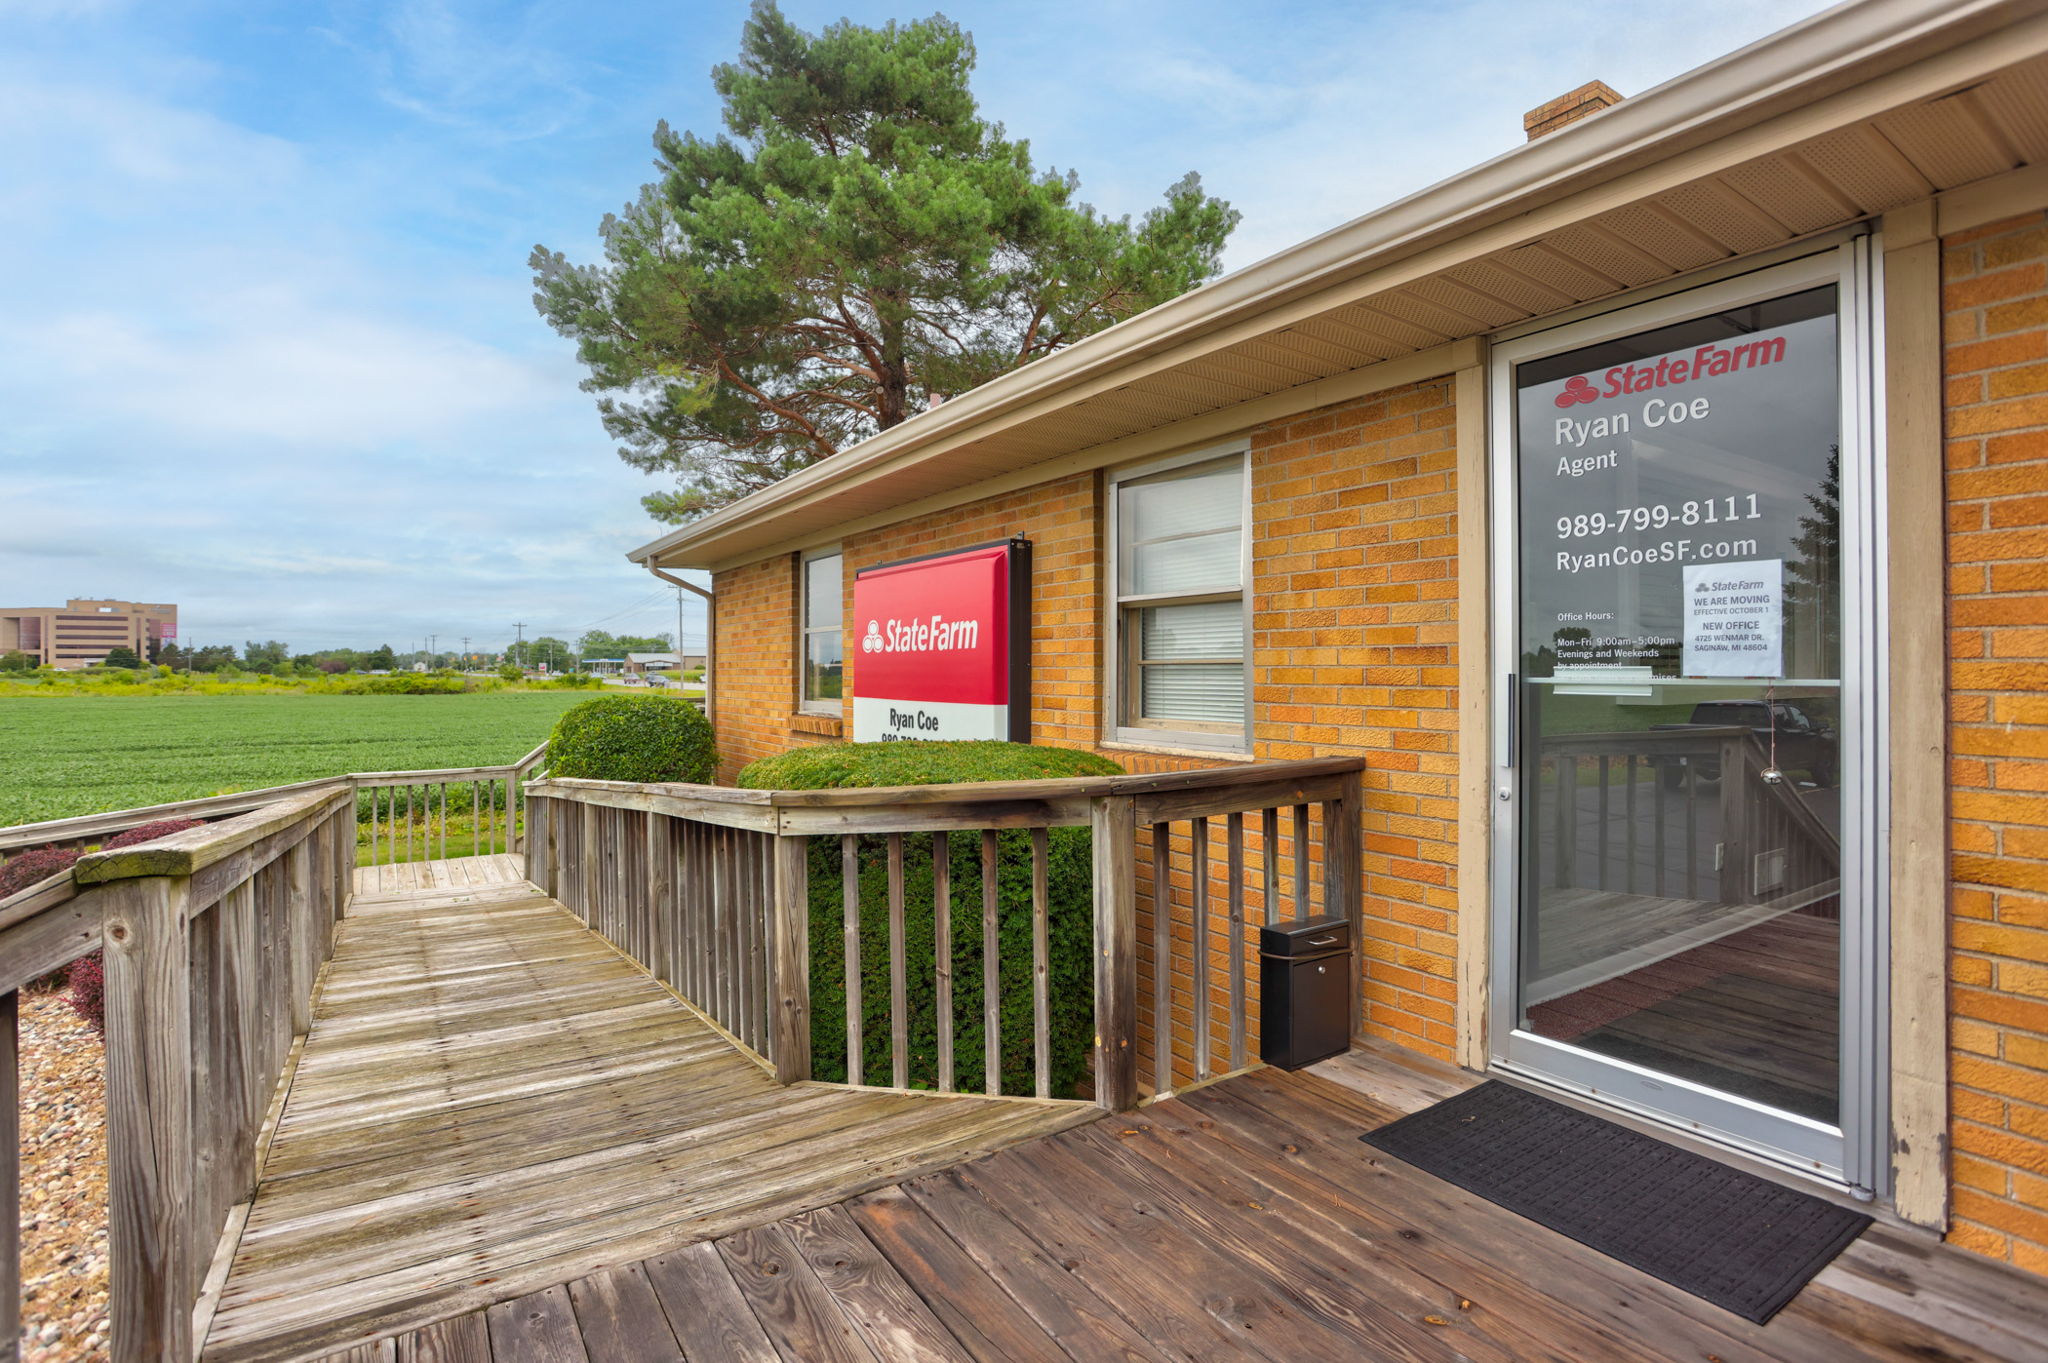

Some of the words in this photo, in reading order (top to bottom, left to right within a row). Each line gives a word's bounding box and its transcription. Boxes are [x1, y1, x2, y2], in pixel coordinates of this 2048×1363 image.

[1555, 411, 1630, 448] Ryan
[1642, 397, 1711, 429] Coe
[1556, 449, 1618, 477] Agent
[1556, 492, 1762, 540] 989-799-8111
[1556, 538, 1758, 573] RyanCoeSF.com
[1694, 598, 1708, 606] WE
[1710, 596, 1728, 606] ARE
[1730, 594, 1770, 605] MOVING
[1557, 612, 1583, 621] Office
[1585, 611, 1616, 620] Hours:
[1693, 607, 1728, 616] EFFECTIVE
[1729, 606, 1763, 615] OCTOBER
[1702, 621, 1723, 631] NEW
[1725, 620, 1760, 630] OFFICE
[1713, 634, 1750, 642] WENMAR
[1751, 633, 1765, 641] DR.
[1557, 649, 1594, 660] Evenings
[1595, 648, 1612, 658] and
[1614, 647, 1660, 658] Weekends
[1694, 645, 1731, 653] SAGINAW,
[889, 707, 915, 732] Ryan
[917, 710, 939, 732] Coe
